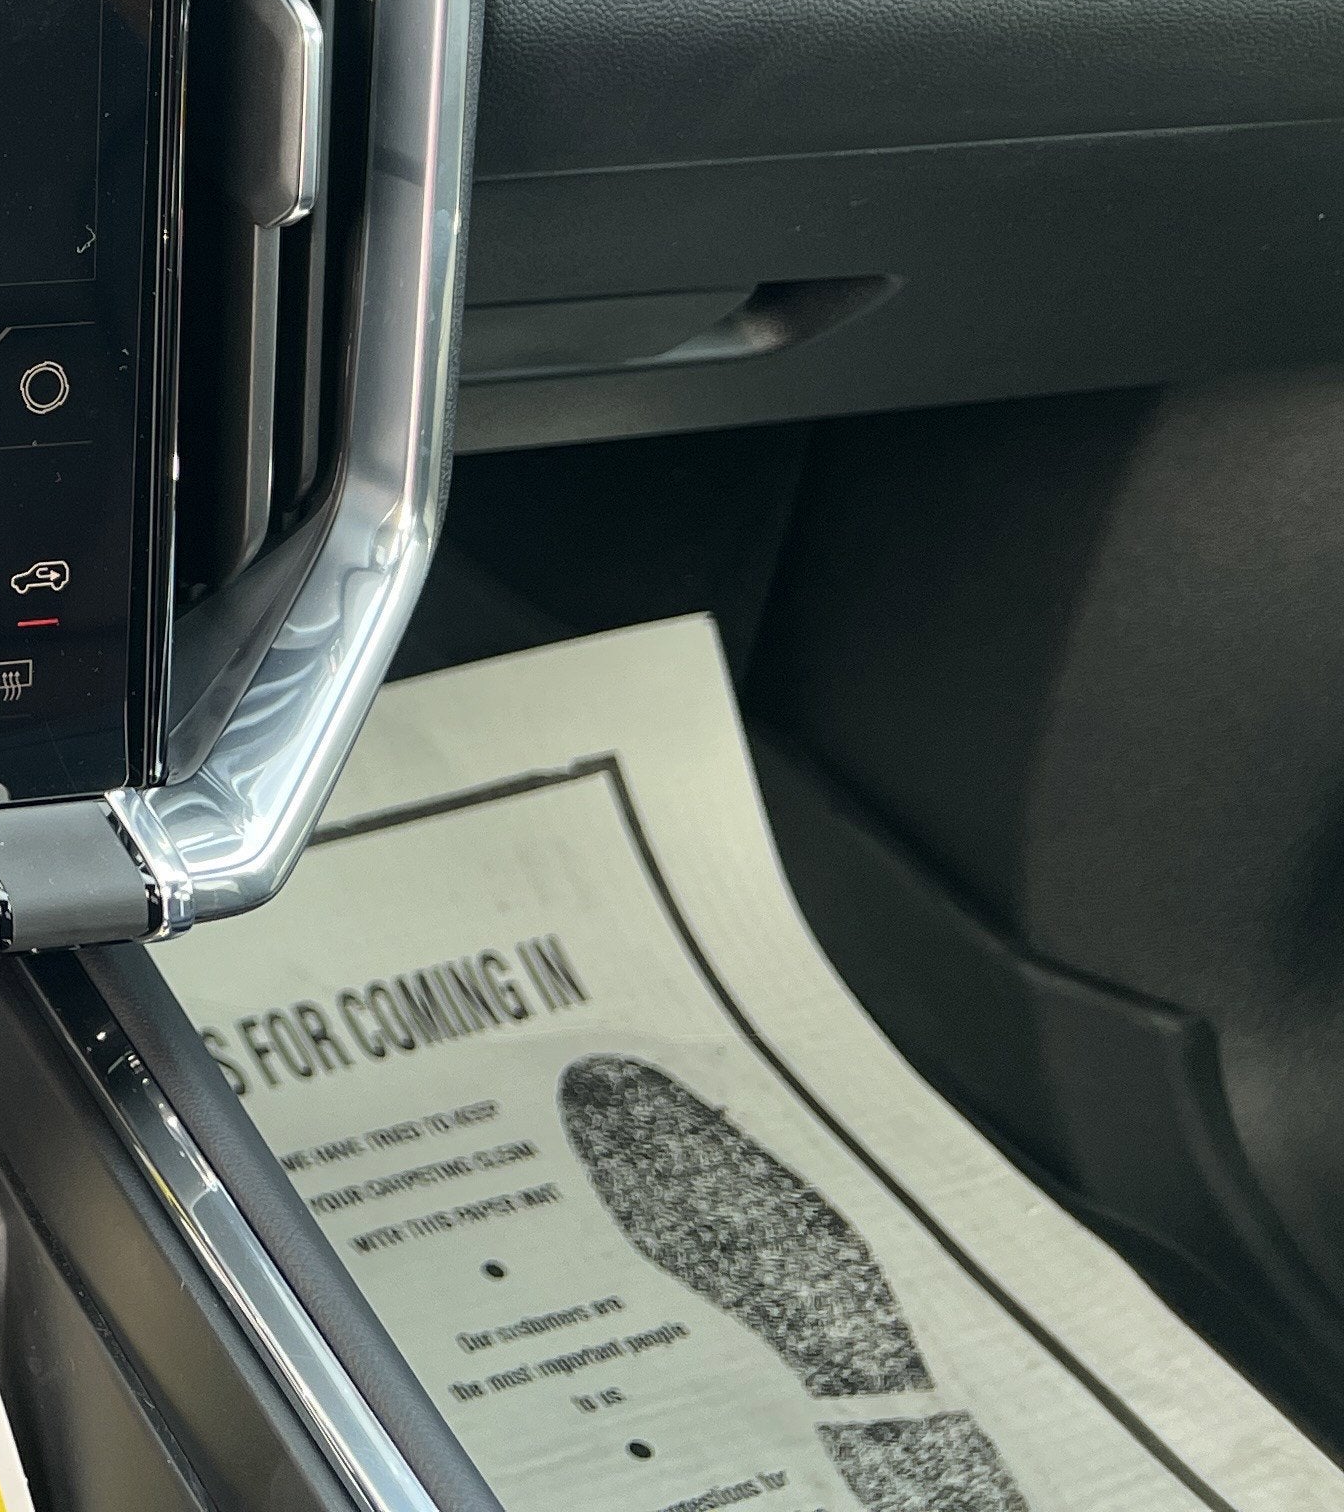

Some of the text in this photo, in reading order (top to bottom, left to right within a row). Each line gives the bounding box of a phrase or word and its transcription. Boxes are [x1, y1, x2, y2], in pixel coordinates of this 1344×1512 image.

[237, 1002, 354, 1086] FOR
[336, 949, 531, 1057] COMING
[514, 934, 592, 1012] IN
